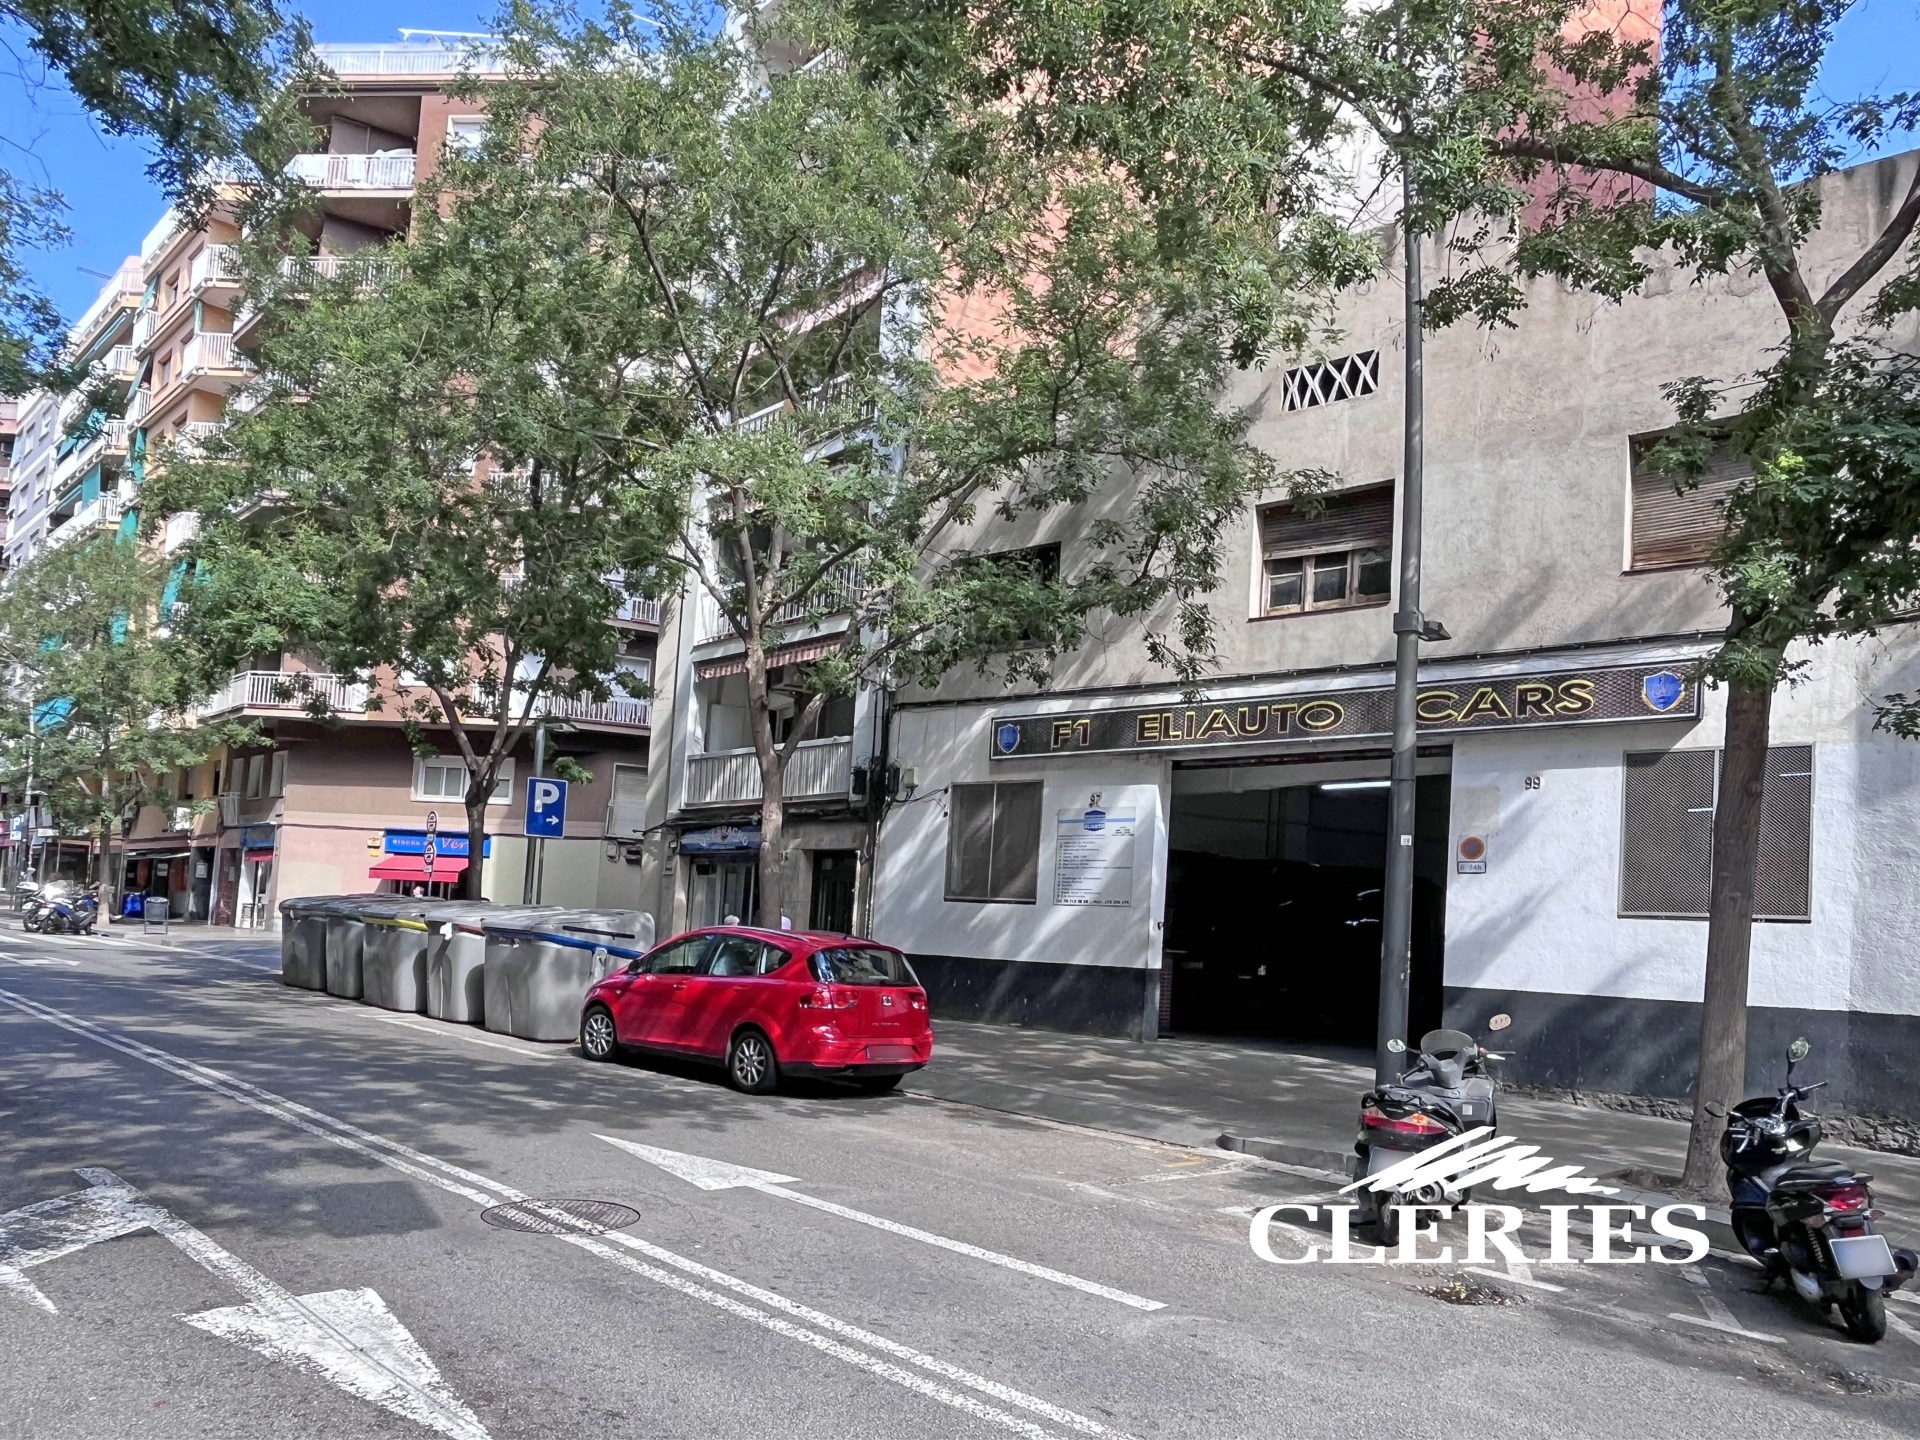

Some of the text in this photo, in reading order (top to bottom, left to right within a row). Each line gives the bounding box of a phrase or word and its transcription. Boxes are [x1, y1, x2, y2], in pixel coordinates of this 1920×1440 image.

[1051, 679, 1595, 748] F1 ELIAUTO CARS
[534, 782, 560, 813] P
[1524, 776, 1541, 790] 99
